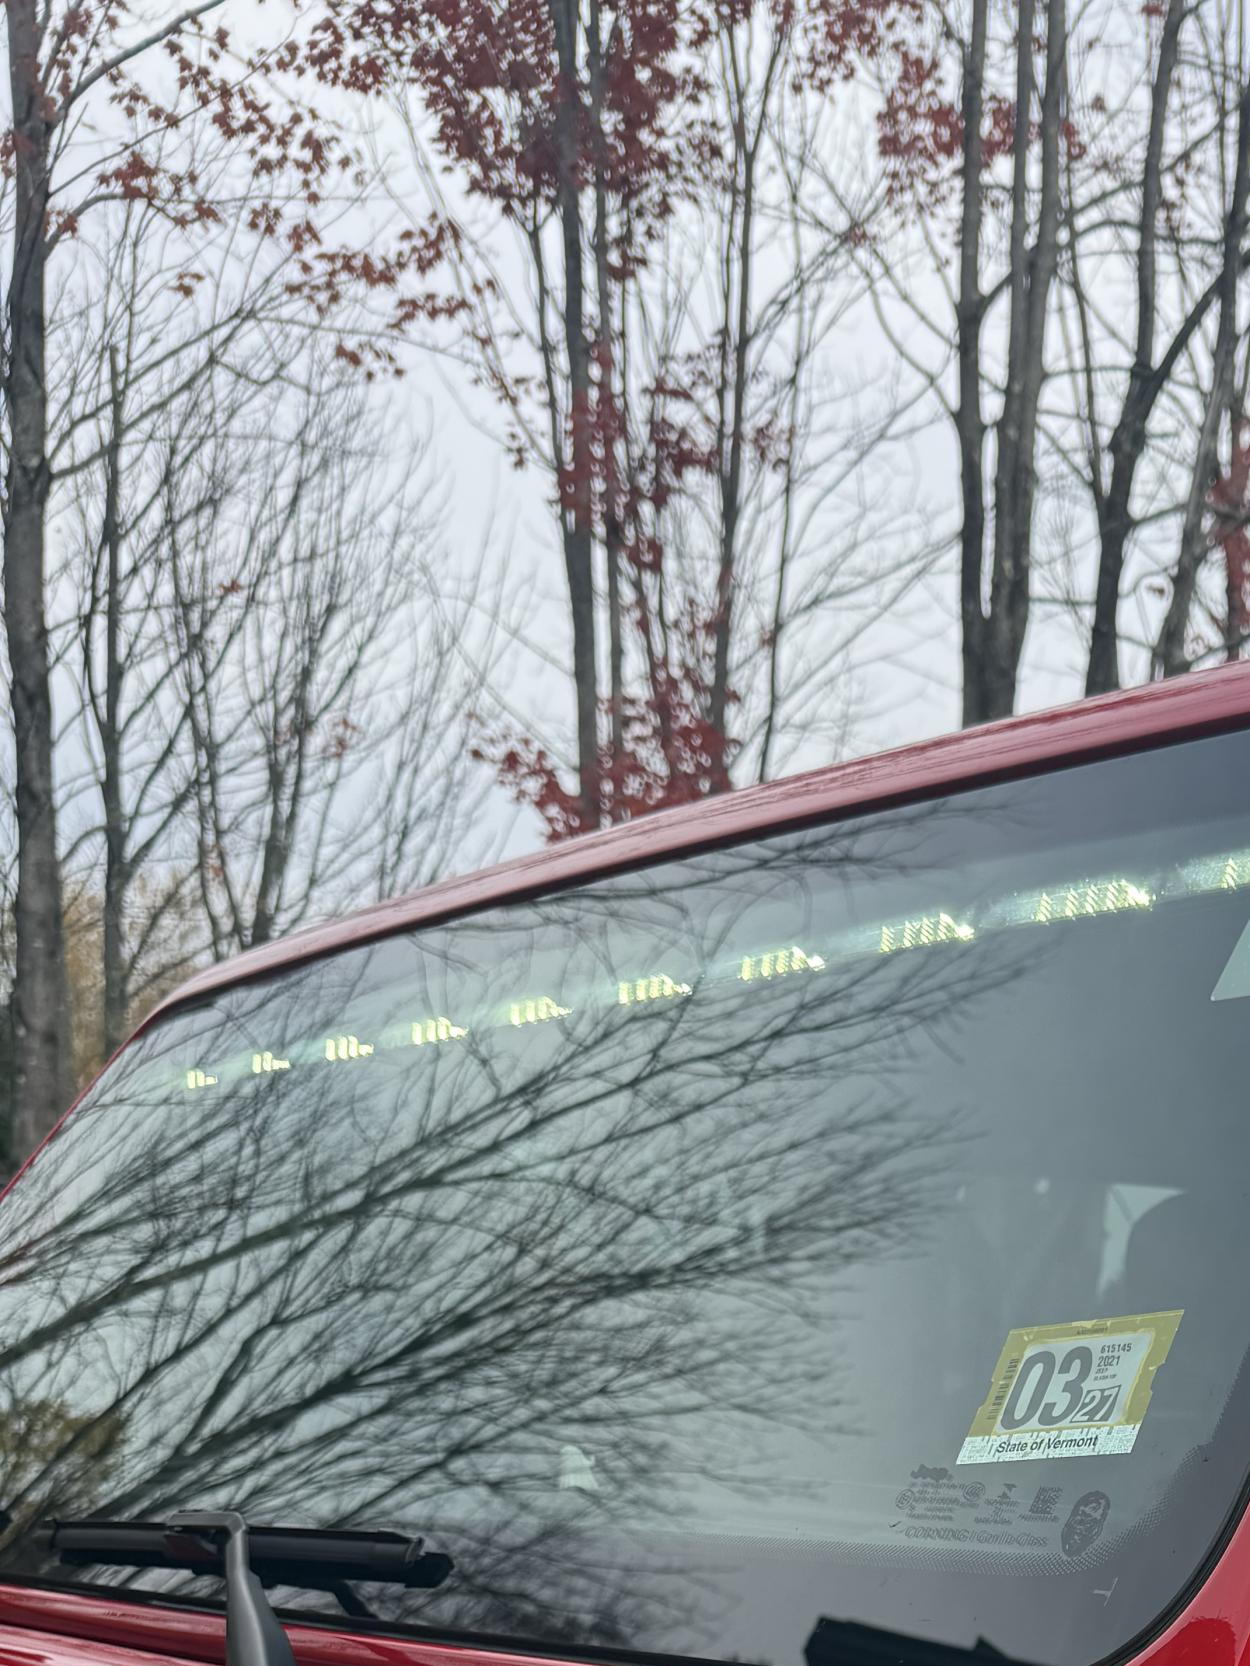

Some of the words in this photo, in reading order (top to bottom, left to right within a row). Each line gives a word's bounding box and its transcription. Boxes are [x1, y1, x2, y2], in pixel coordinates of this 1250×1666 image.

[1097, 1355, 1121, 1368] 2021
[1000, 1345, 1093, 1431] 03
[1073, 1389, 1117, 1423] 27
[996, 1440, 1028, 1454] State
[1028, 1438, 1045, 1452] of
[1046, 1434, 1098, 1450] Vermont
